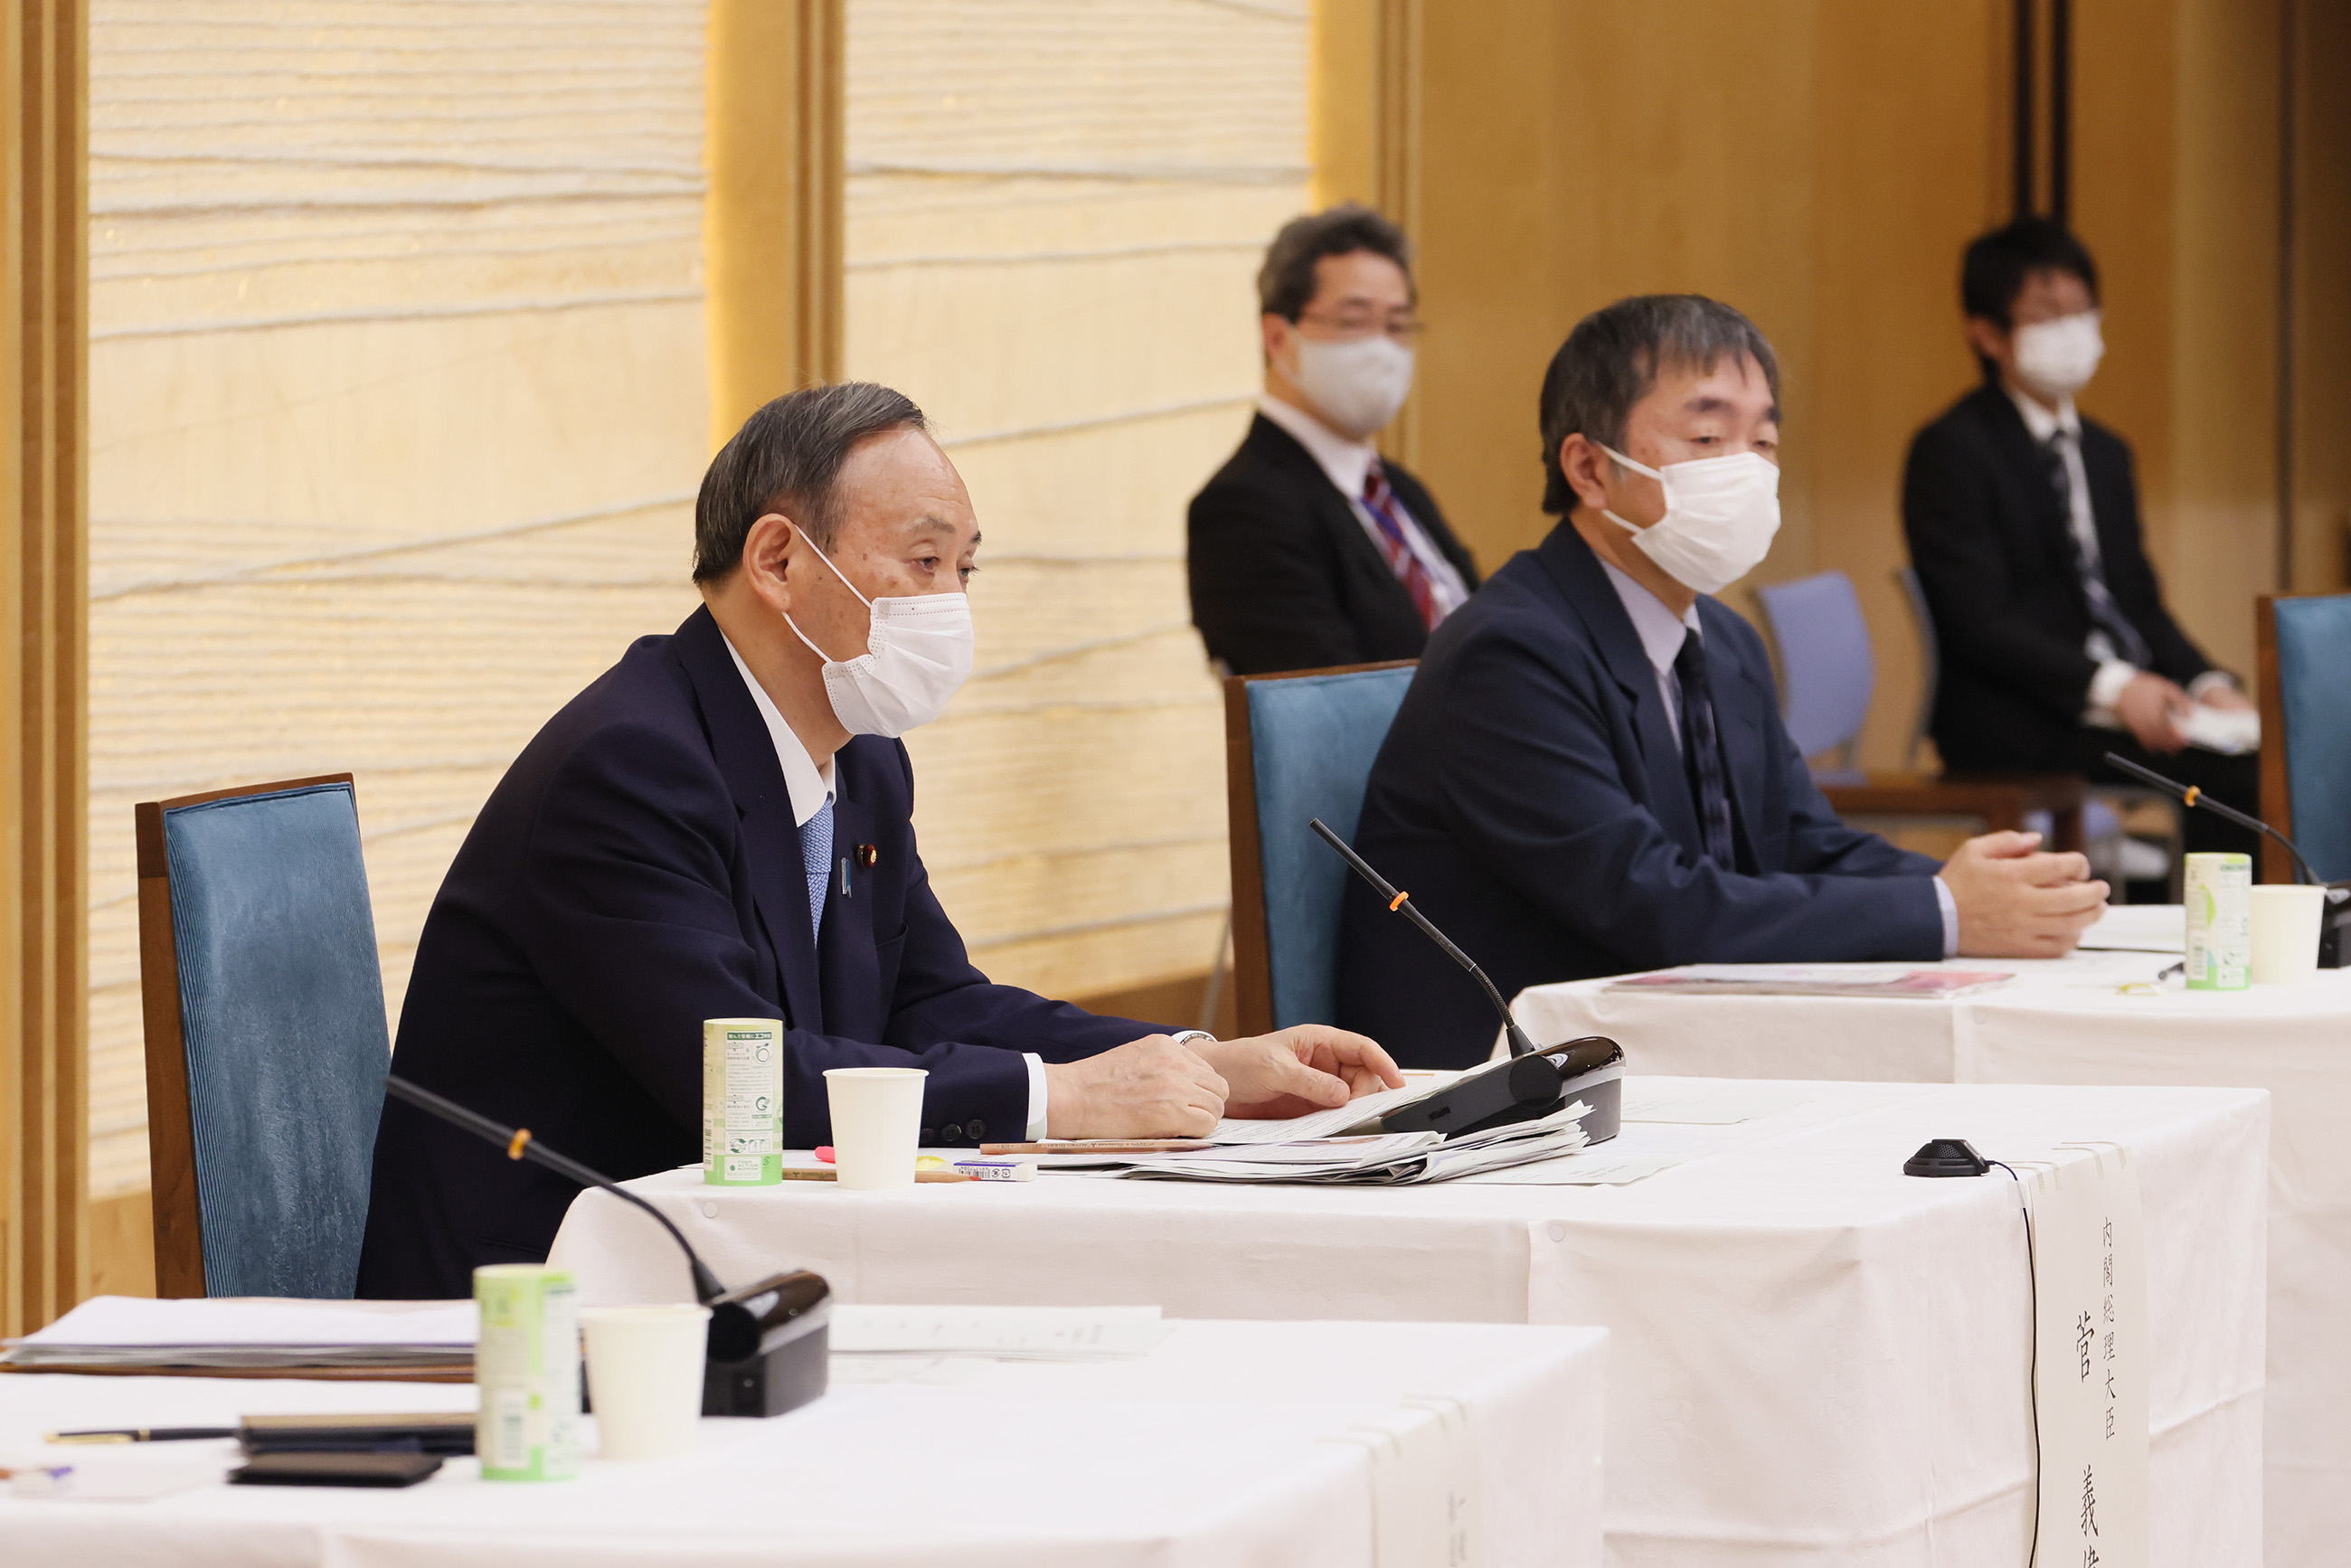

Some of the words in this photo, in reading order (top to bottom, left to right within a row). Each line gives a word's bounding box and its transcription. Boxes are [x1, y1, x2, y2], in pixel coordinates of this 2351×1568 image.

[2102, 1216, 2116, 1441] 内閣総理大臣
